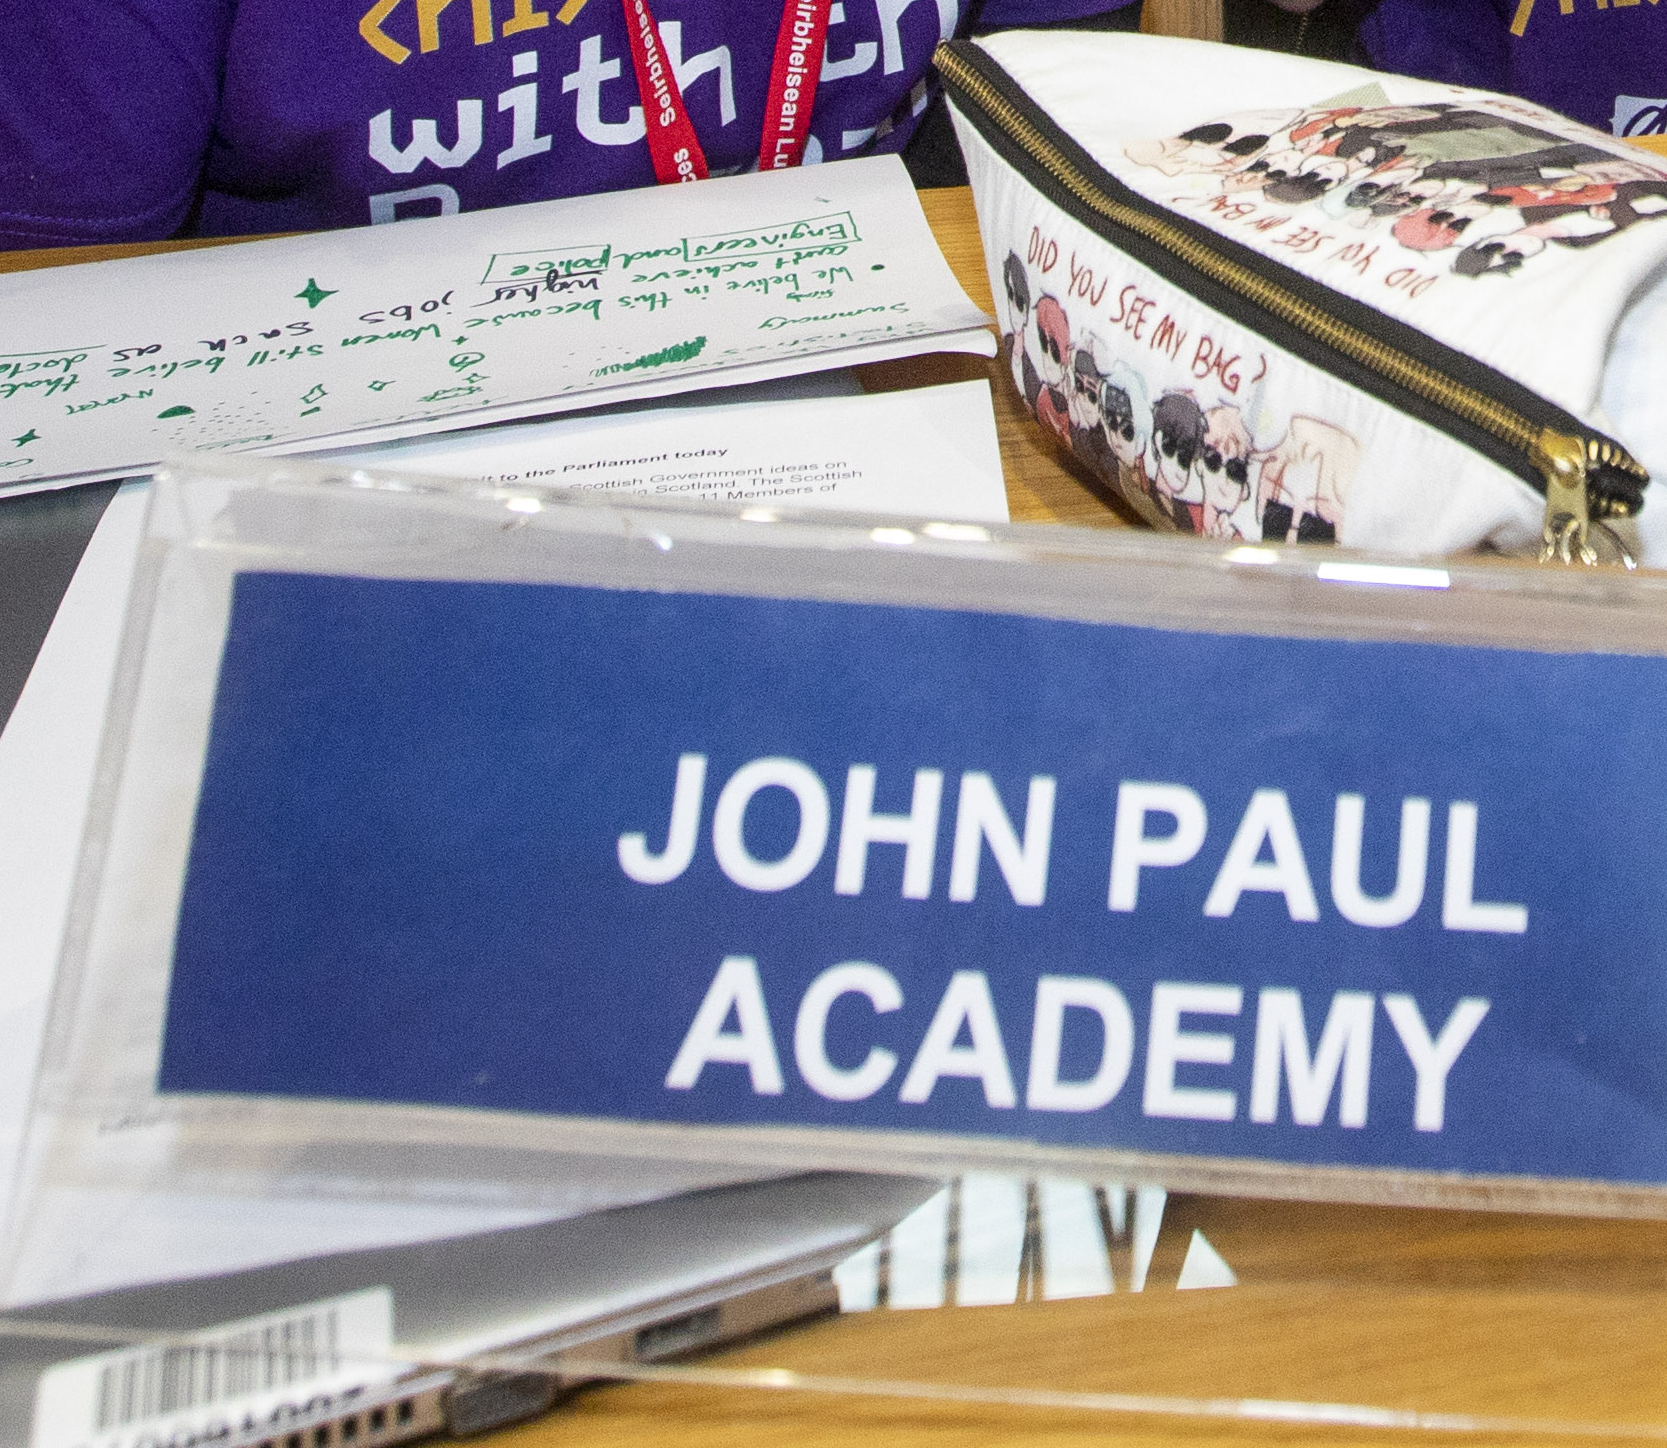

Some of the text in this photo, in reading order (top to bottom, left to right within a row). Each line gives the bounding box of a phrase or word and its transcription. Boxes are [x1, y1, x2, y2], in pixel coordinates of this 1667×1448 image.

[510, 219, 846, 283] Engineers and police
[1271, 226, 1335, 254] SEE
[631, 259, 759, 286] achieve
[802, 266, 853, 283] We
[1384, 268, 1439, 299] DID
[617, 293, 669, 315] this
[683, 284, 710, 301] in
[1025, 223, 1062, 272] DID
[1108, 285, 1153, 342] SEE
[1150, 310, 1191, 366] MY
[357, 292, 455, 329] jobs
[463, 298, 604, 329] because
[757, 303, 910, 331] Summary
[112, 343, 162, 363] as
[247, 344, 324, 366] still
[0, 373, 78, 399] that
[498, 446, 730, 483] to the Parliament today
[649, 466, 767, 485] Government
[768, 461, 820, 477] ideas
[825, 459, 848, 470] on
[751, 474, 785, 487] The
[788, 468, 864, 484] Scottish
[725, 485, 801, 502] Members
[804, 481, 839, 494] of
[617, 751, 1530, 935] JOHN PAUL
[664, 952, 1493, 1133] ACADEMY
